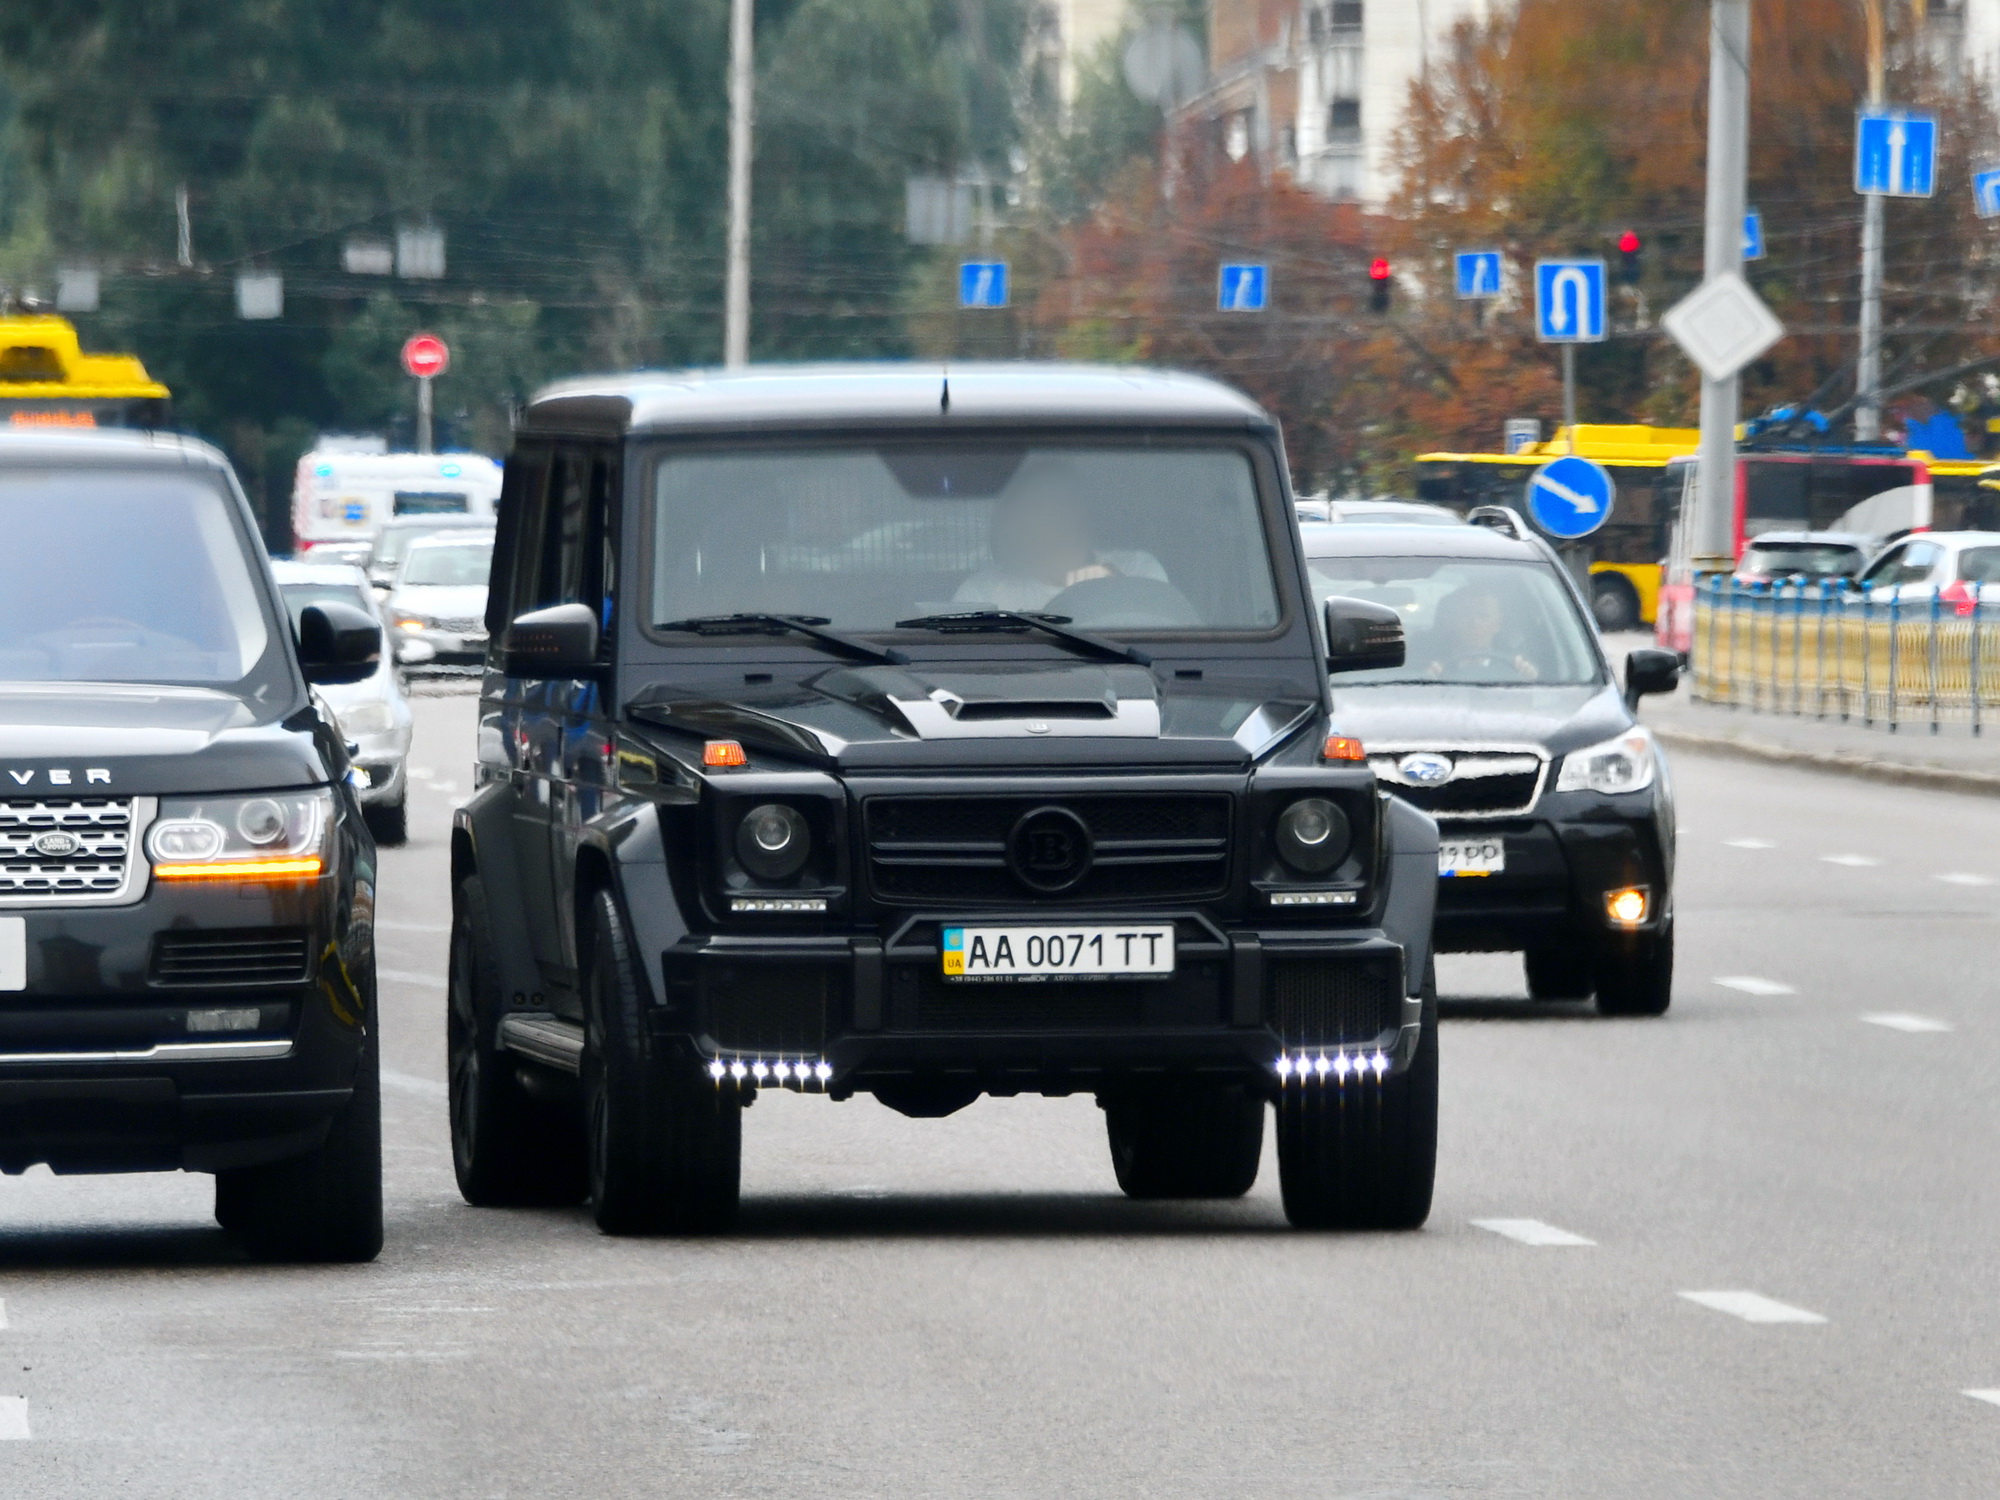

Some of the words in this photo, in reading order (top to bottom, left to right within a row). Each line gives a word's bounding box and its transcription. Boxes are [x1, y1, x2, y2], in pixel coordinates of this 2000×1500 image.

[968, 935, 1016, 969] AA
[1027, 934, 1102, 967] 0071
[1115, 933, 1163, 966] TT
[947, 959, 962, 969] UA
